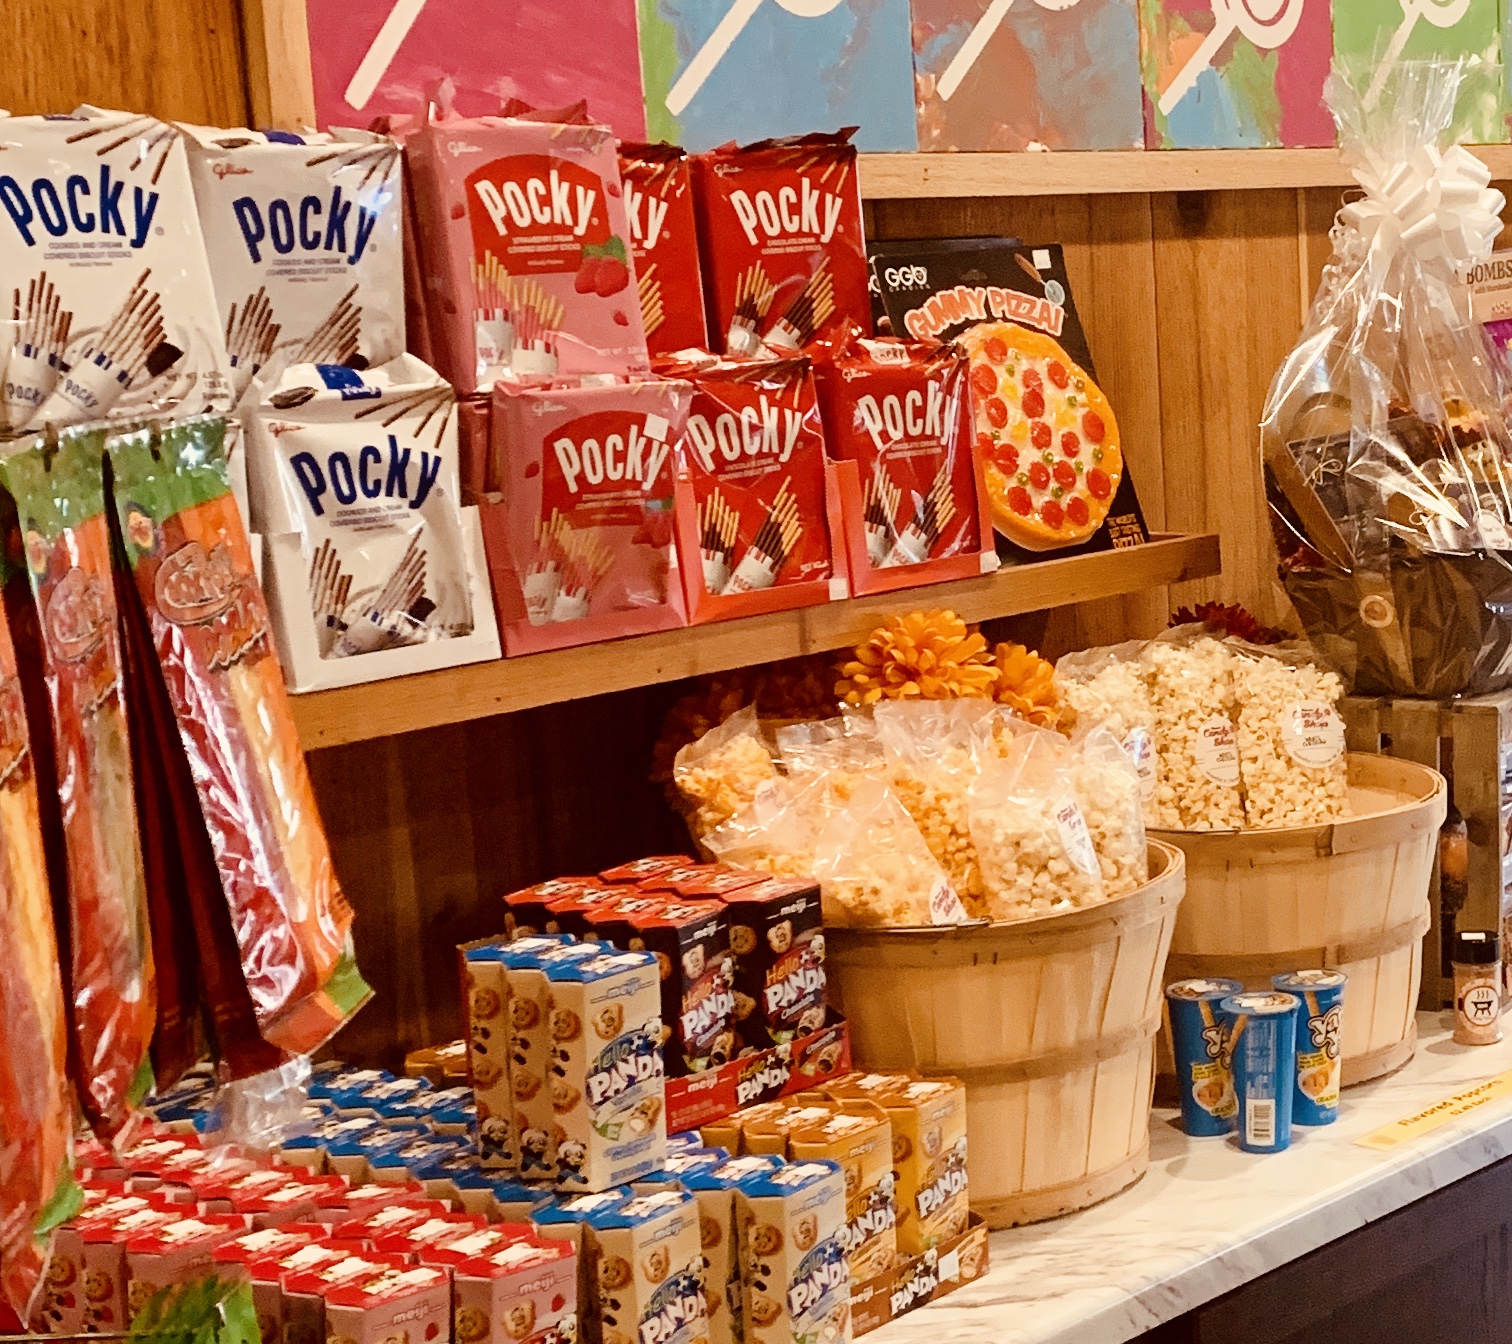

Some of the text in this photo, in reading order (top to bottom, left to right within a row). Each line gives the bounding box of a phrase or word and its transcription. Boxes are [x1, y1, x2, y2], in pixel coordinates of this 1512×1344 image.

[0, 164, 159, 248] Pocky
[232, 186, 377, 265] Pocky
[474, 169, 596, 236] Pocky
[730, 177, 843, 245] Pocky
[904, 285, 987, 340] GUMMY
[687, 394, 803, 472] Pocky
[857, 380, 956, 450] Pocky
[290, 435, 442, 516] Pocky
[554, 424, 671, 494] Pocky
[765, 964, 828, 1014] PANDA
[766, 957, 800, 986] Hello
[680, 989, 736, 1040] PANDA
[588, 1050, 664, 1104] PANDA
[688, 1074, 718, 1092] meiji
[735, 1067, 791, 1105] PANDA
[1398, 1080, 1503, 1126] Flavored Popcorn
[917, 1167, 968, 1218] PANDA
[519, 1273, 554, 1295] meiji
[788, 1257, 850, 1316] PANDA
[890, 1274, 939, 1316] PANDA
[393, 1304, 429, 1325] meiji
